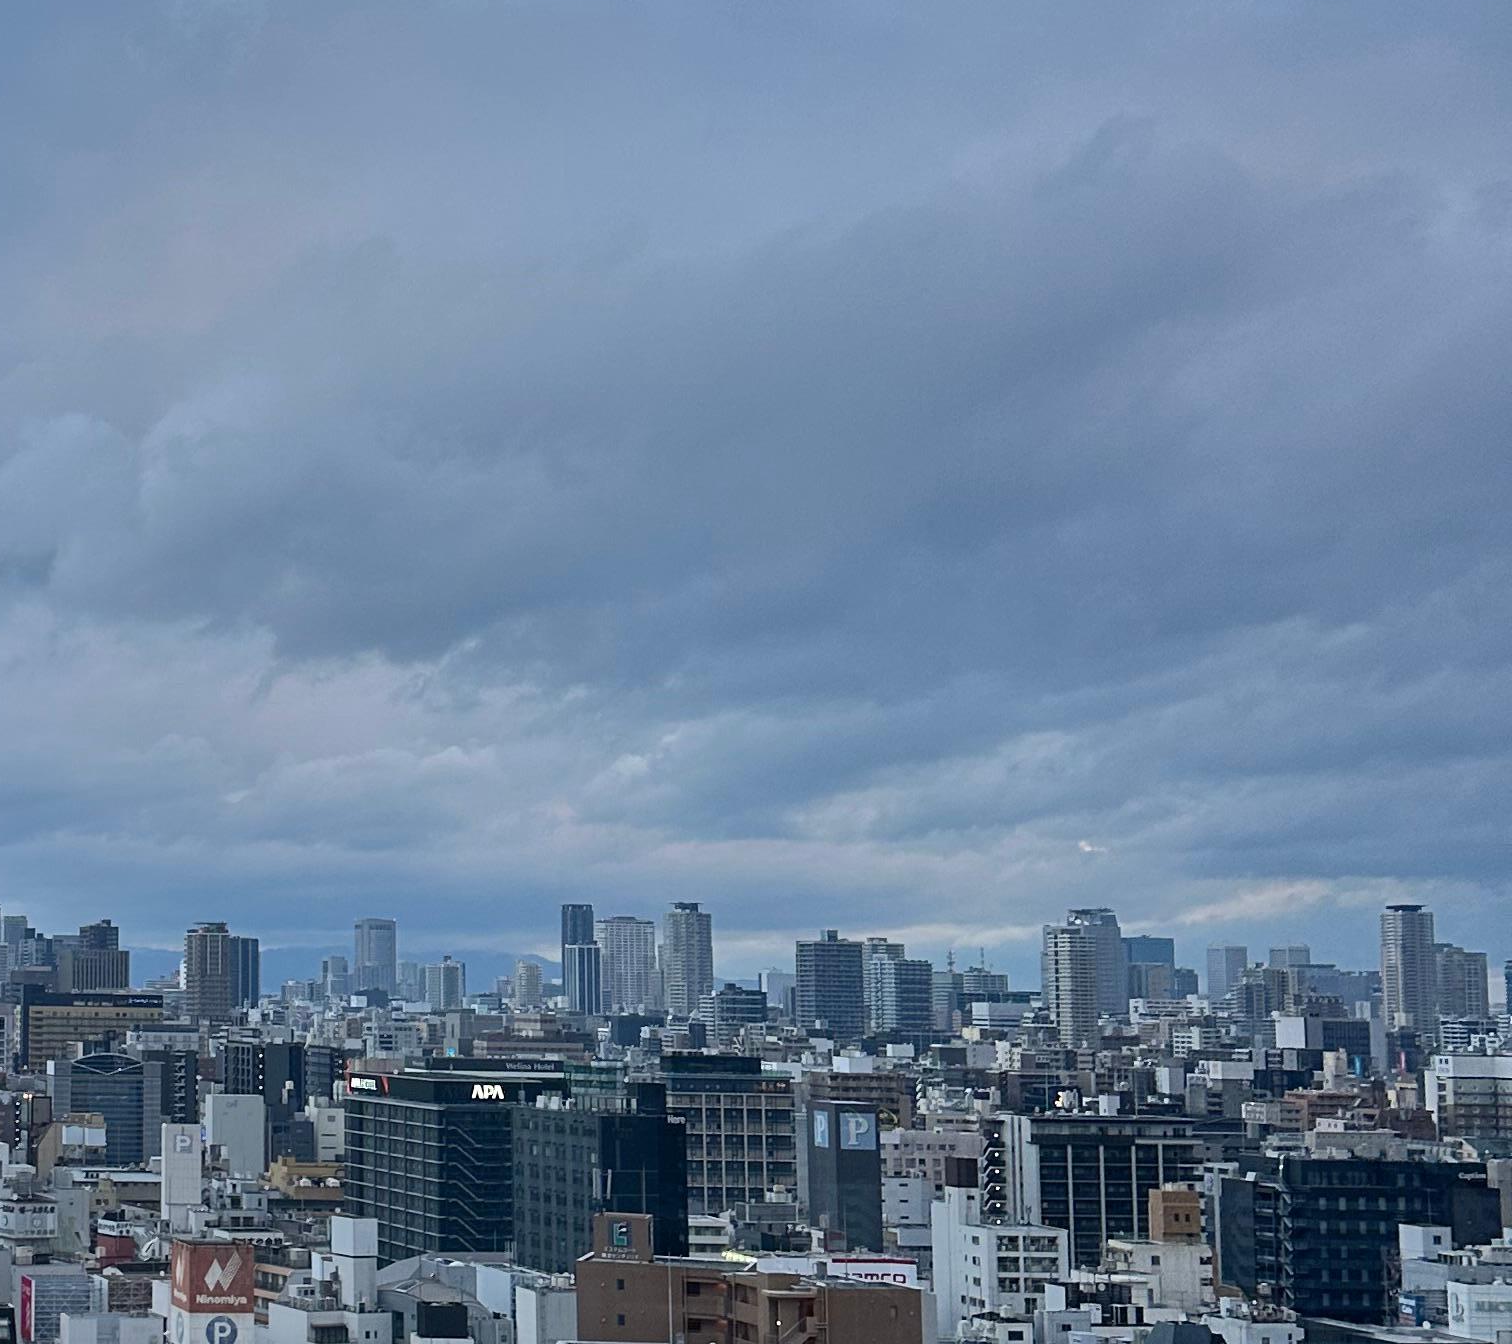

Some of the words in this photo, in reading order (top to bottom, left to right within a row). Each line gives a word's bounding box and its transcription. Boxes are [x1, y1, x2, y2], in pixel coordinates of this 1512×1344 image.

[471, 1084, 505, 1099] APA
[816, 1115, 825, 1143] P
[847, 1117, 869, 1146] P
[196, 1294, 248, 1306] Ninomiya
